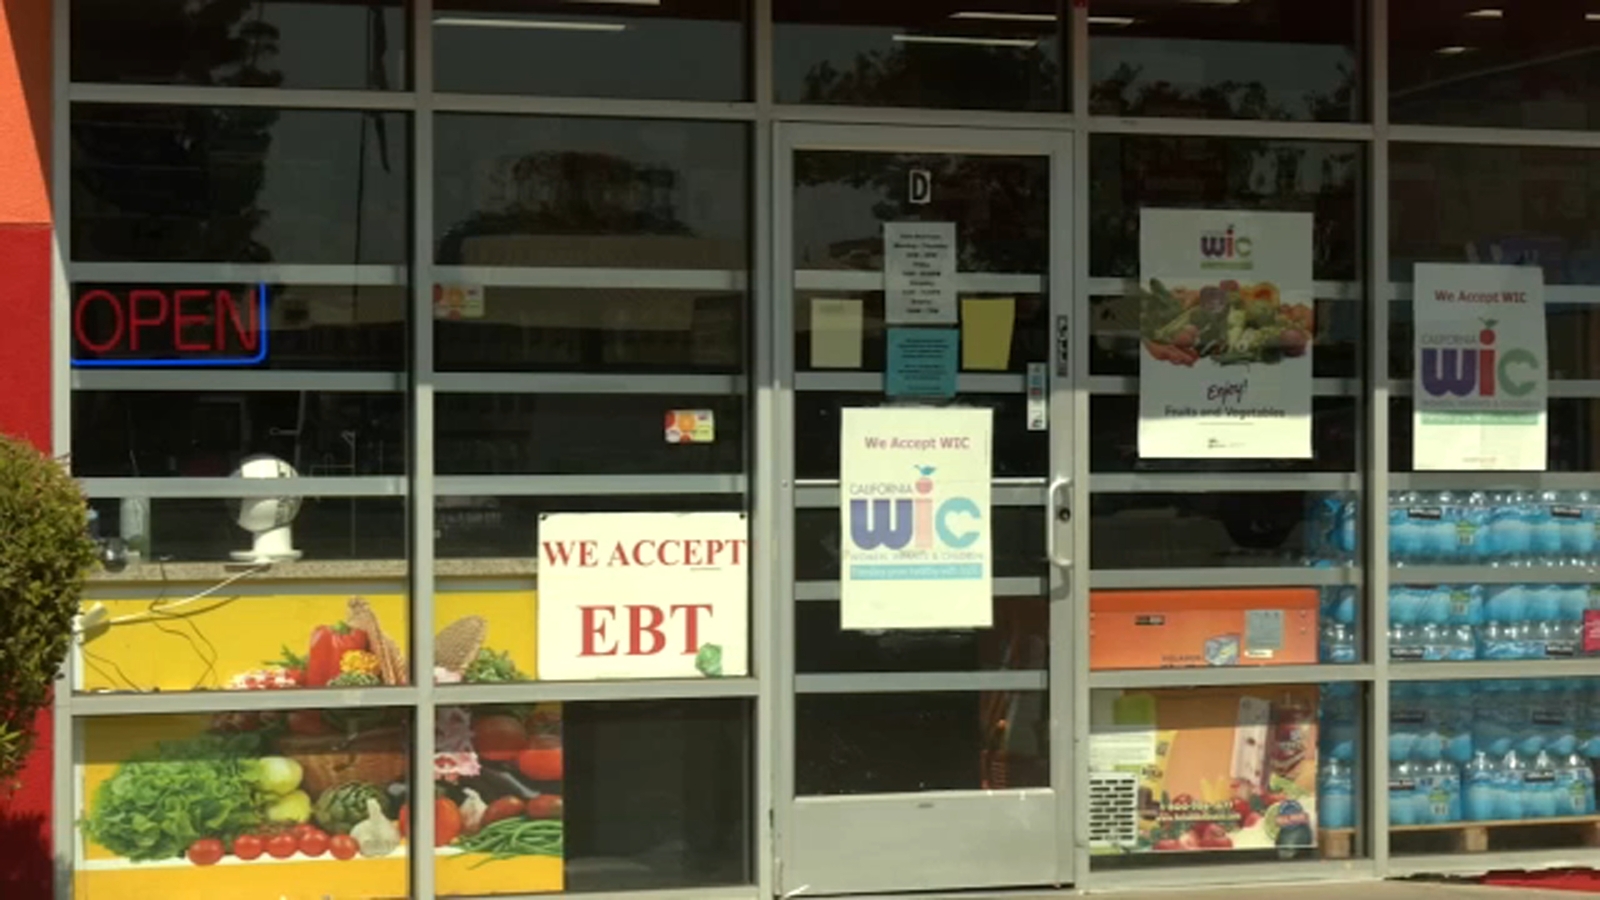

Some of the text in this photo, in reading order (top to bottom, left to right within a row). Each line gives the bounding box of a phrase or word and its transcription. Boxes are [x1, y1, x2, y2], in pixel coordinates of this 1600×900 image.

[912, 172, 928, 200] D
[1200, 229, 1253, 257] wic
[1434, 290, 1527, 303] We Accept WIC
[74, 289, 257, 352] OPEN
[1421, 329, 1540, 397] wic
[1207, 379, 1248, 404] Enjoy!
[1164, 406, 1286, 420] Fruits and Vegetables
[865, 437, 970, 451] We Accept WIC
[850, 483, 913, 495] CALIFORNIA
[850, 477, 982, 550] wic
[542, 539, 746, 567] WE ACCEPT
[576, 604, 714, 657] EBT
